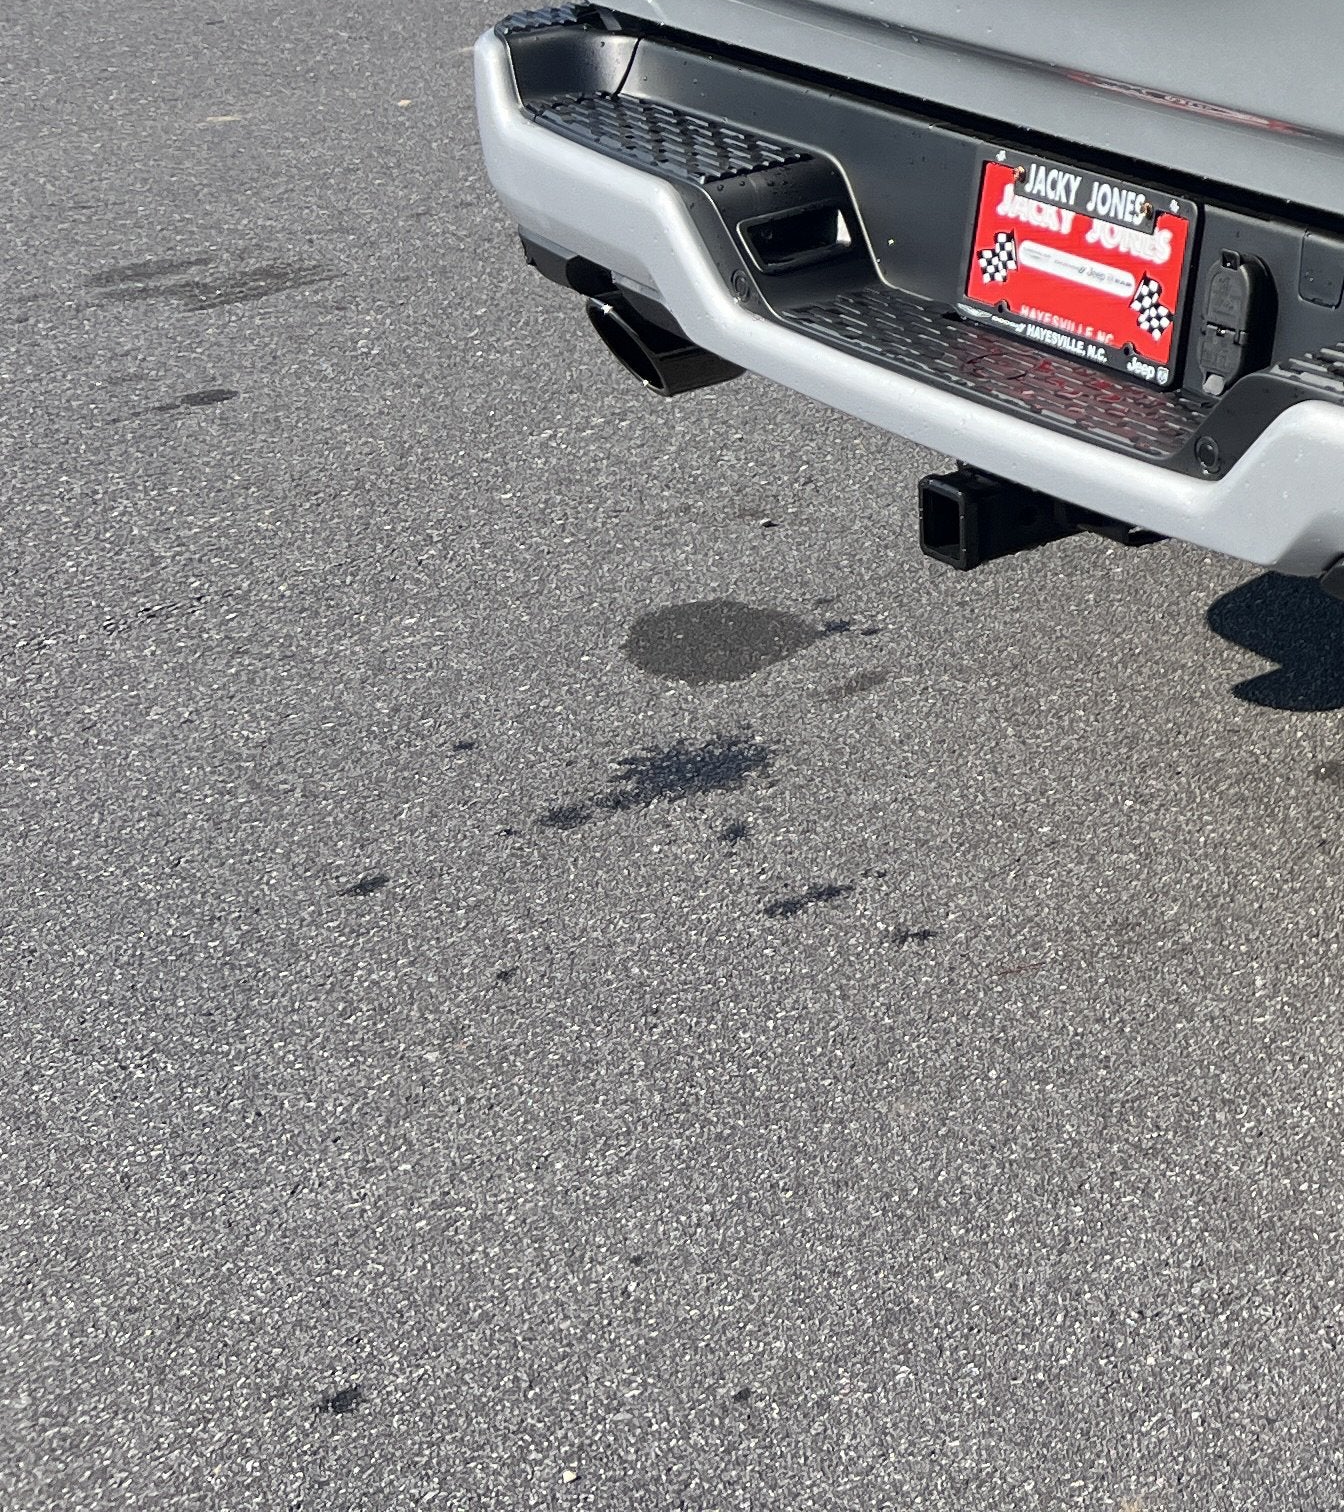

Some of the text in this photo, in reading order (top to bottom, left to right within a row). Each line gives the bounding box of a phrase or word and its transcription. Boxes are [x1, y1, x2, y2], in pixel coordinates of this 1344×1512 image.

[1024, 163, 1147, 225] JACKY JONES
[1126, 356, 1156, 380] Jeep
